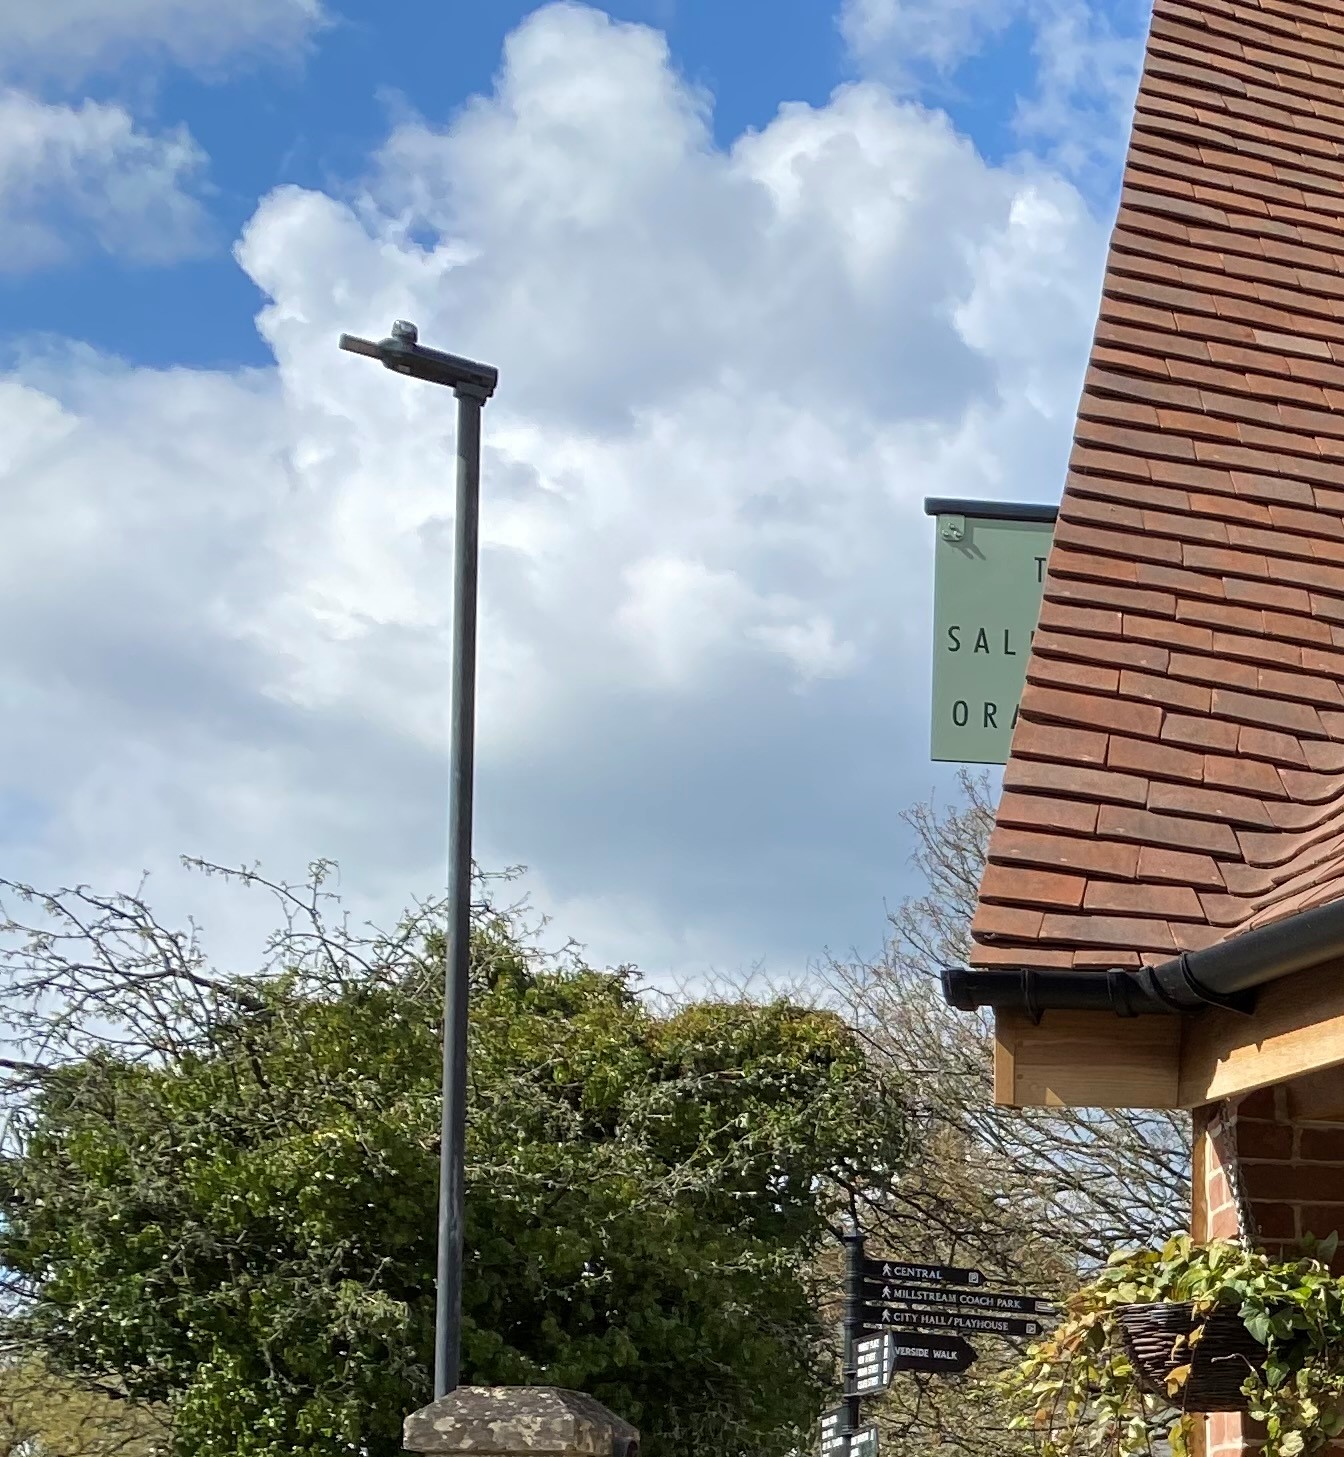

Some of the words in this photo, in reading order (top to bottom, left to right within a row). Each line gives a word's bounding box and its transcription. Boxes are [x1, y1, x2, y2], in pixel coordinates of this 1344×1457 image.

[947, 625, 1034, 656] SAL
[893, 1266, 942, 1280] CENTRAL
[893, 1288, 957, 1303] MILLSTREAM
[959, 1295, 994, 1306] COACH
[996, 1298, 1022, 1309] PARK
[893, 1312, 919, 1323] CITY
[932, 1349, 958, 1361] WALK
